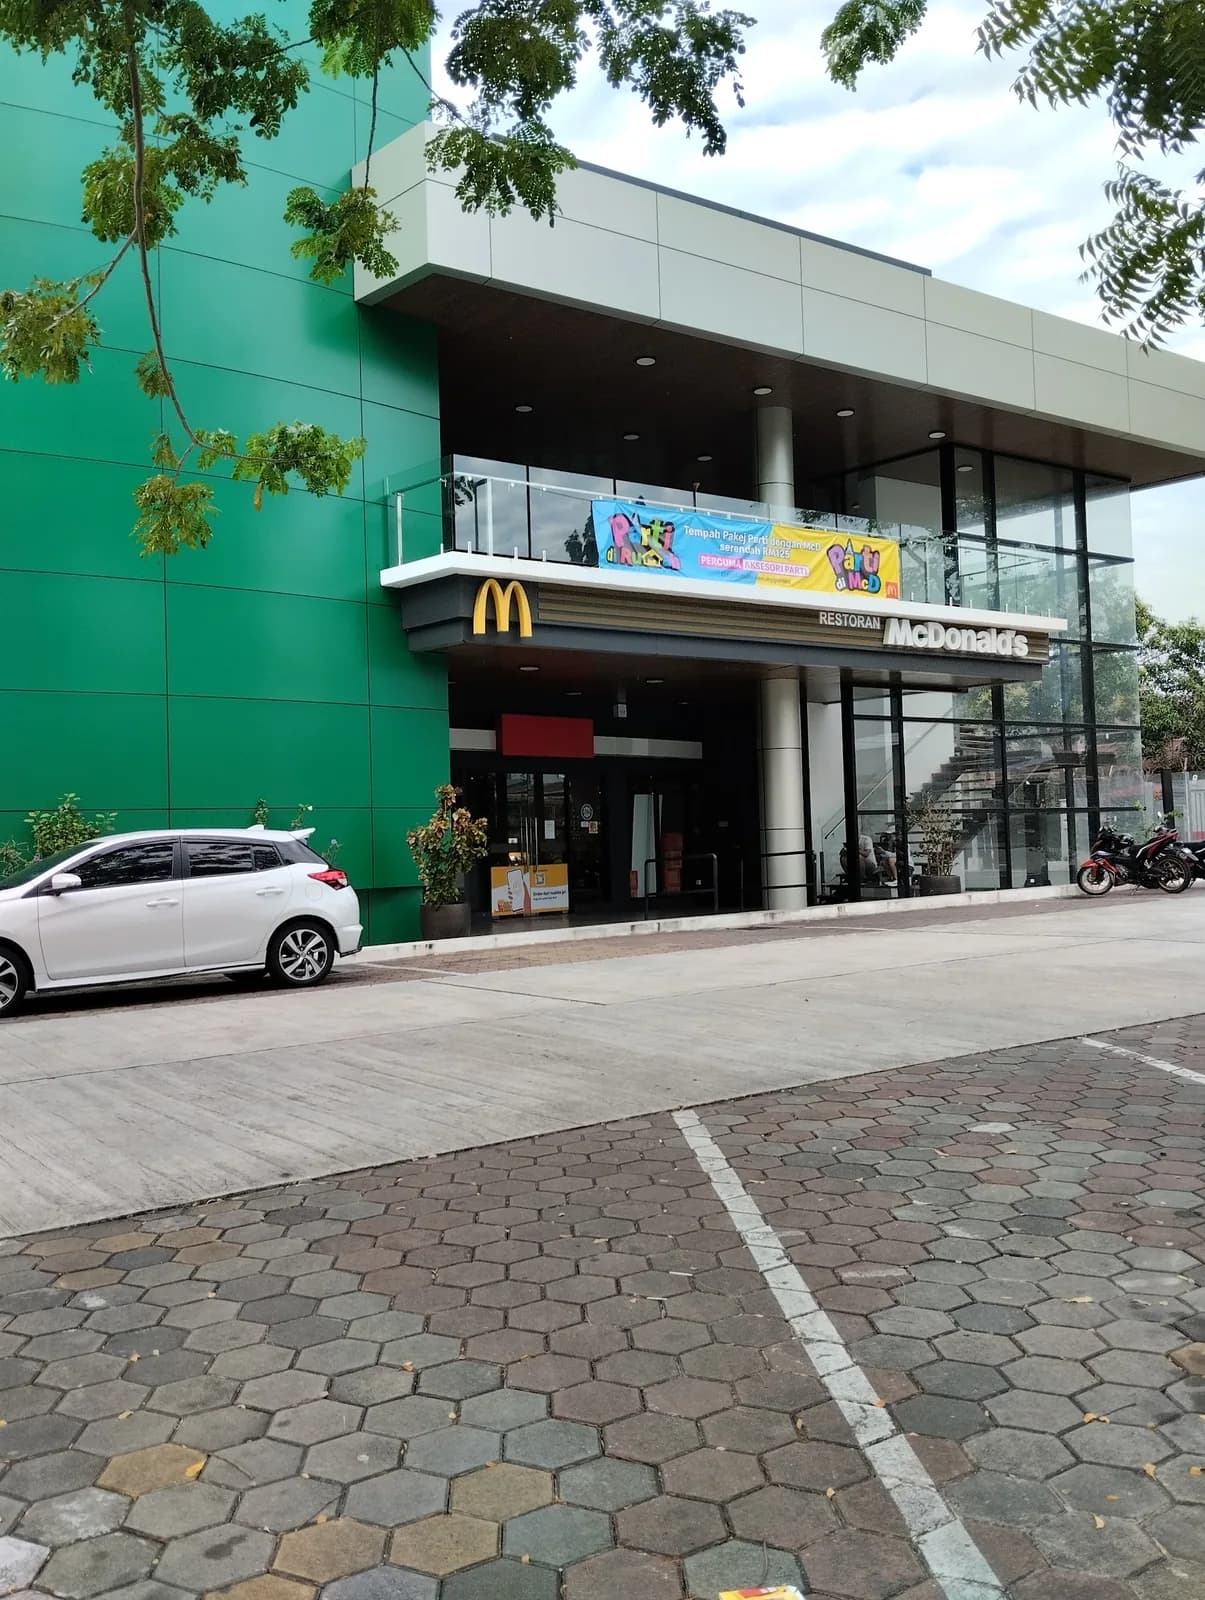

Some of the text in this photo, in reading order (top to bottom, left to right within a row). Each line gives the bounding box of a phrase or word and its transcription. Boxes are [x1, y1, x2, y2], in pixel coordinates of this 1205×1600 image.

[684, 525, 721, 540] Tempah
[723, 530, 747, 545] Pakej
[770, 537, 802, 550] dengan
[719, 542, 761, 555] serendah
[700, 556, 808, 577] PERCUMA AKSESORI PARTI
[836, 572, 881, 594] di McD
[819, 611, 881, 630] RESTORAN
[882, 618, 1029, 657] McDonald's
